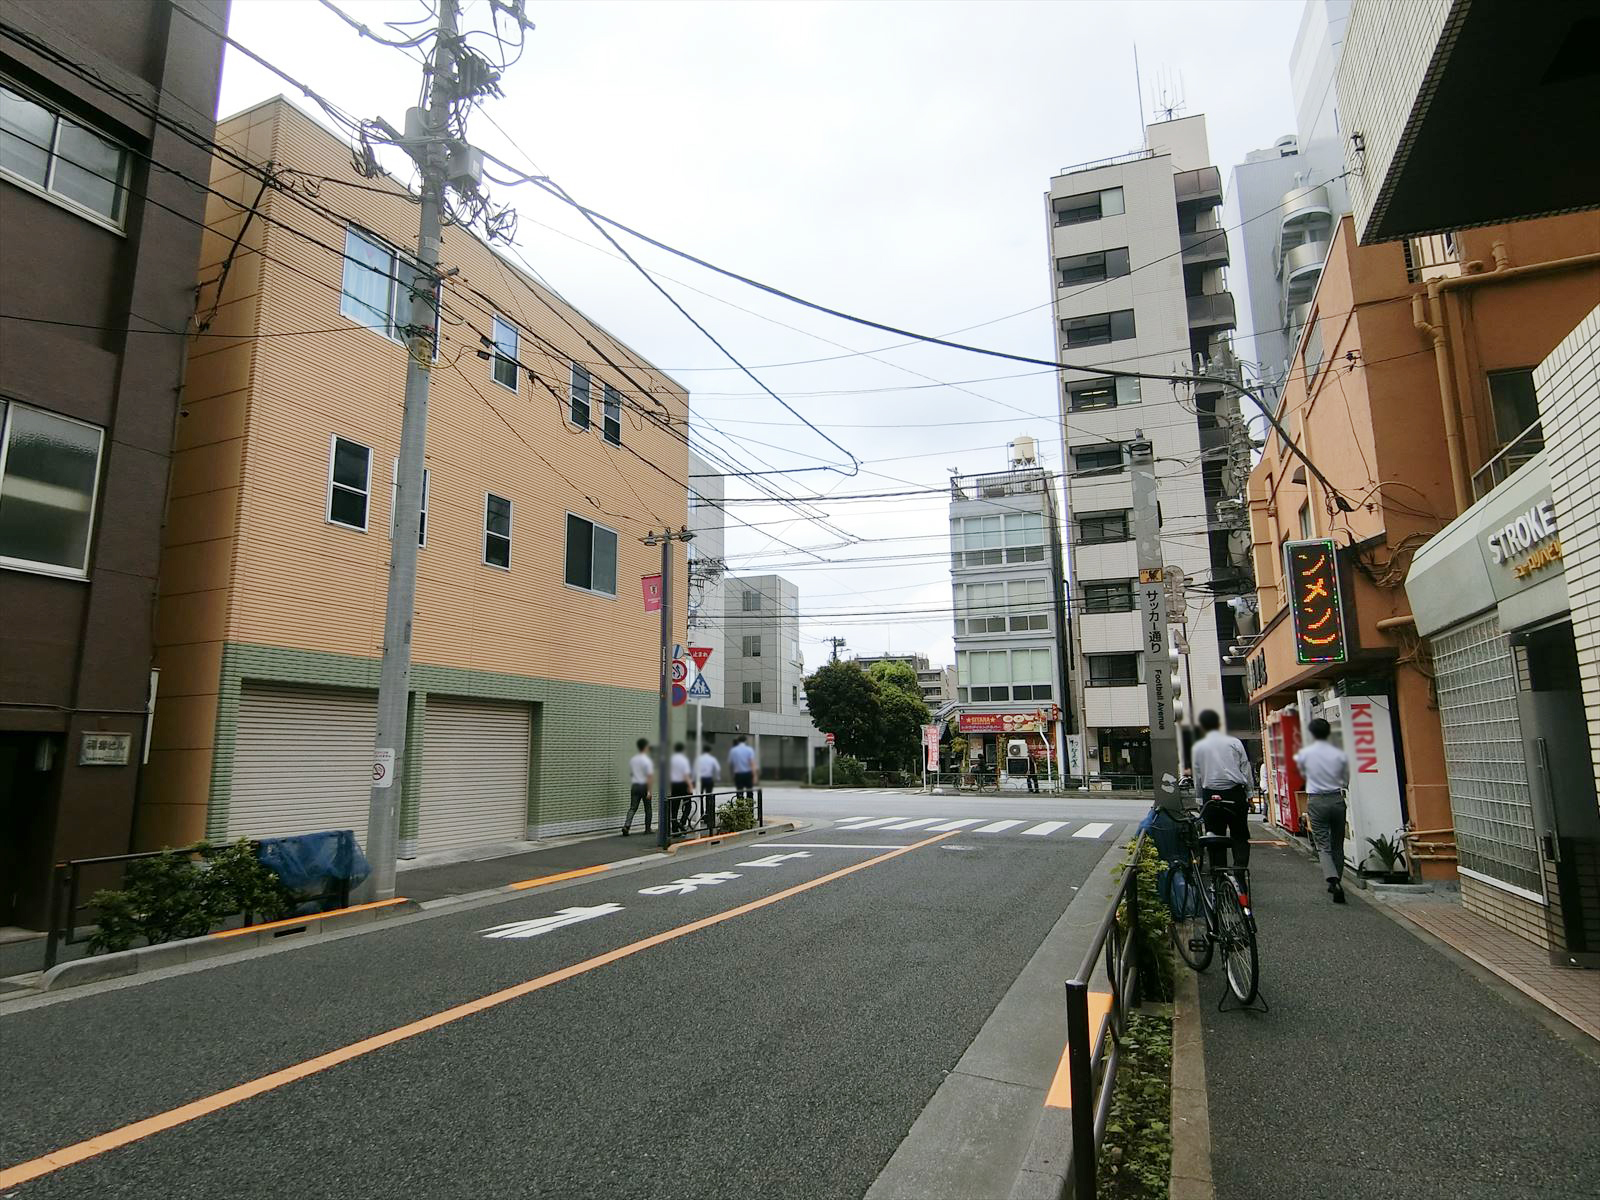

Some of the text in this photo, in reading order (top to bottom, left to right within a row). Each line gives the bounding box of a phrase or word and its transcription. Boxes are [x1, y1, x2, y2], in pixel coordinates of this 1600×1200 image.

[1487, 500, 1558, 564] STROKE
[692, 650, 709, 658] 止まれ
[1145, 590, 1162, 654] サッカー通り
[1154, 669, 1166, 731] Football Avenue
[1350, 703, 1379, 774] KIRIN
[476, 850, 815, 939] 止まれ
